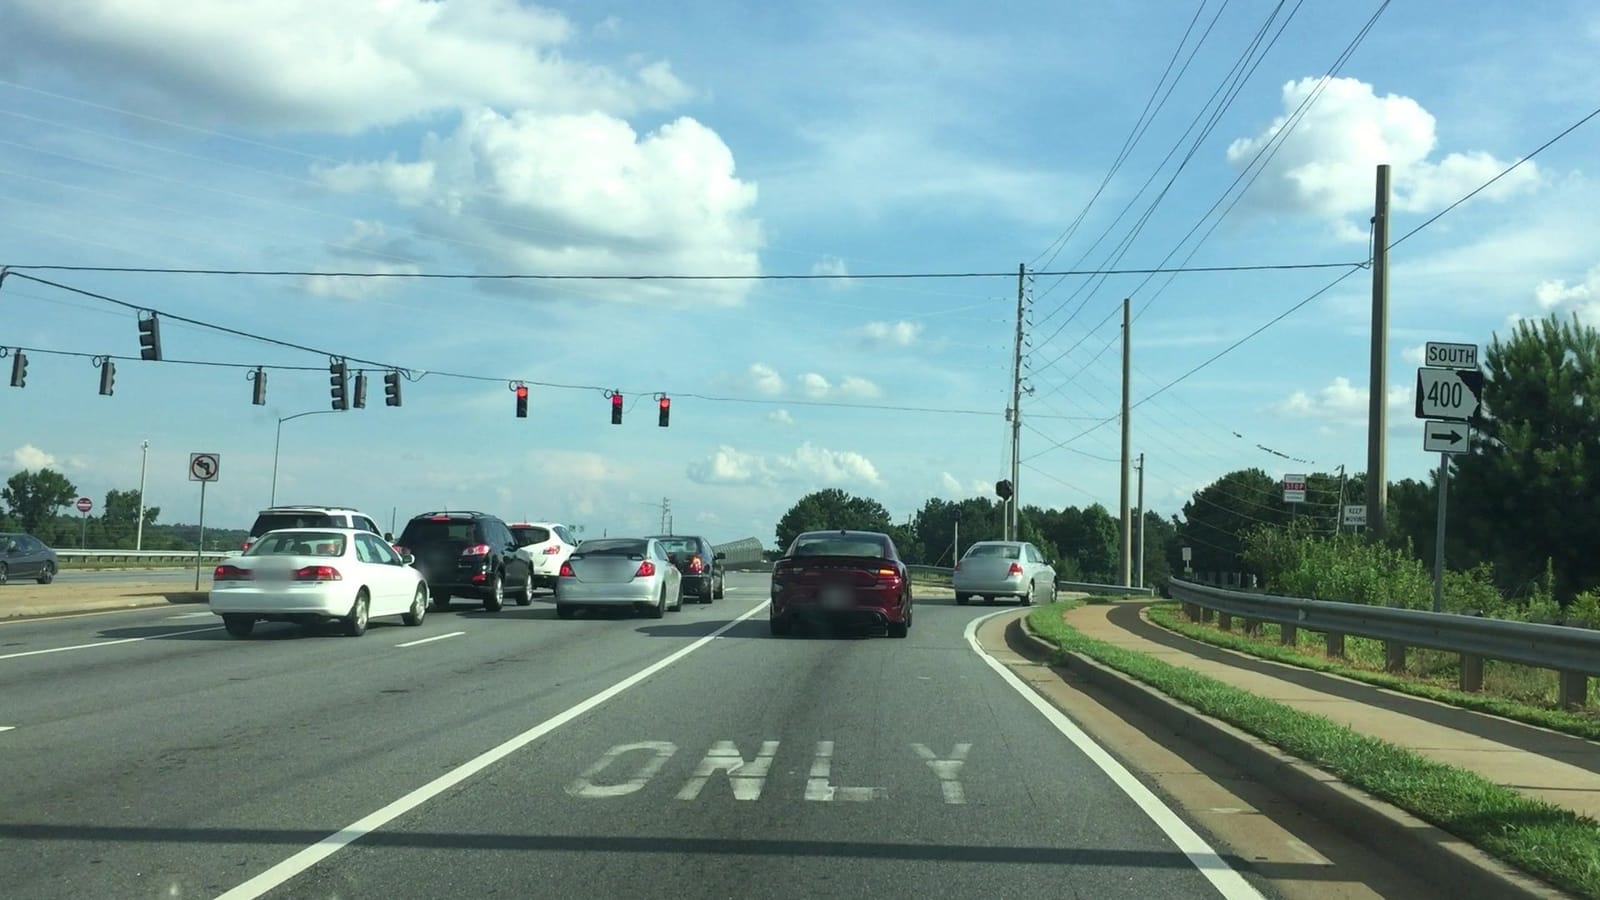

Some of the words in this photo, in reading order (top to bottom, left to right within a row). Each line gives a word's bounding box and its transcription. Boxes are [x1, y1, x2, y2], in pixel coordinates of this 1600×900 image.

[1429, 346, 1474, 363] SOUTH
[1427, 381, 1462, 408] 400
[564, 740, 973, 804] ONLY
